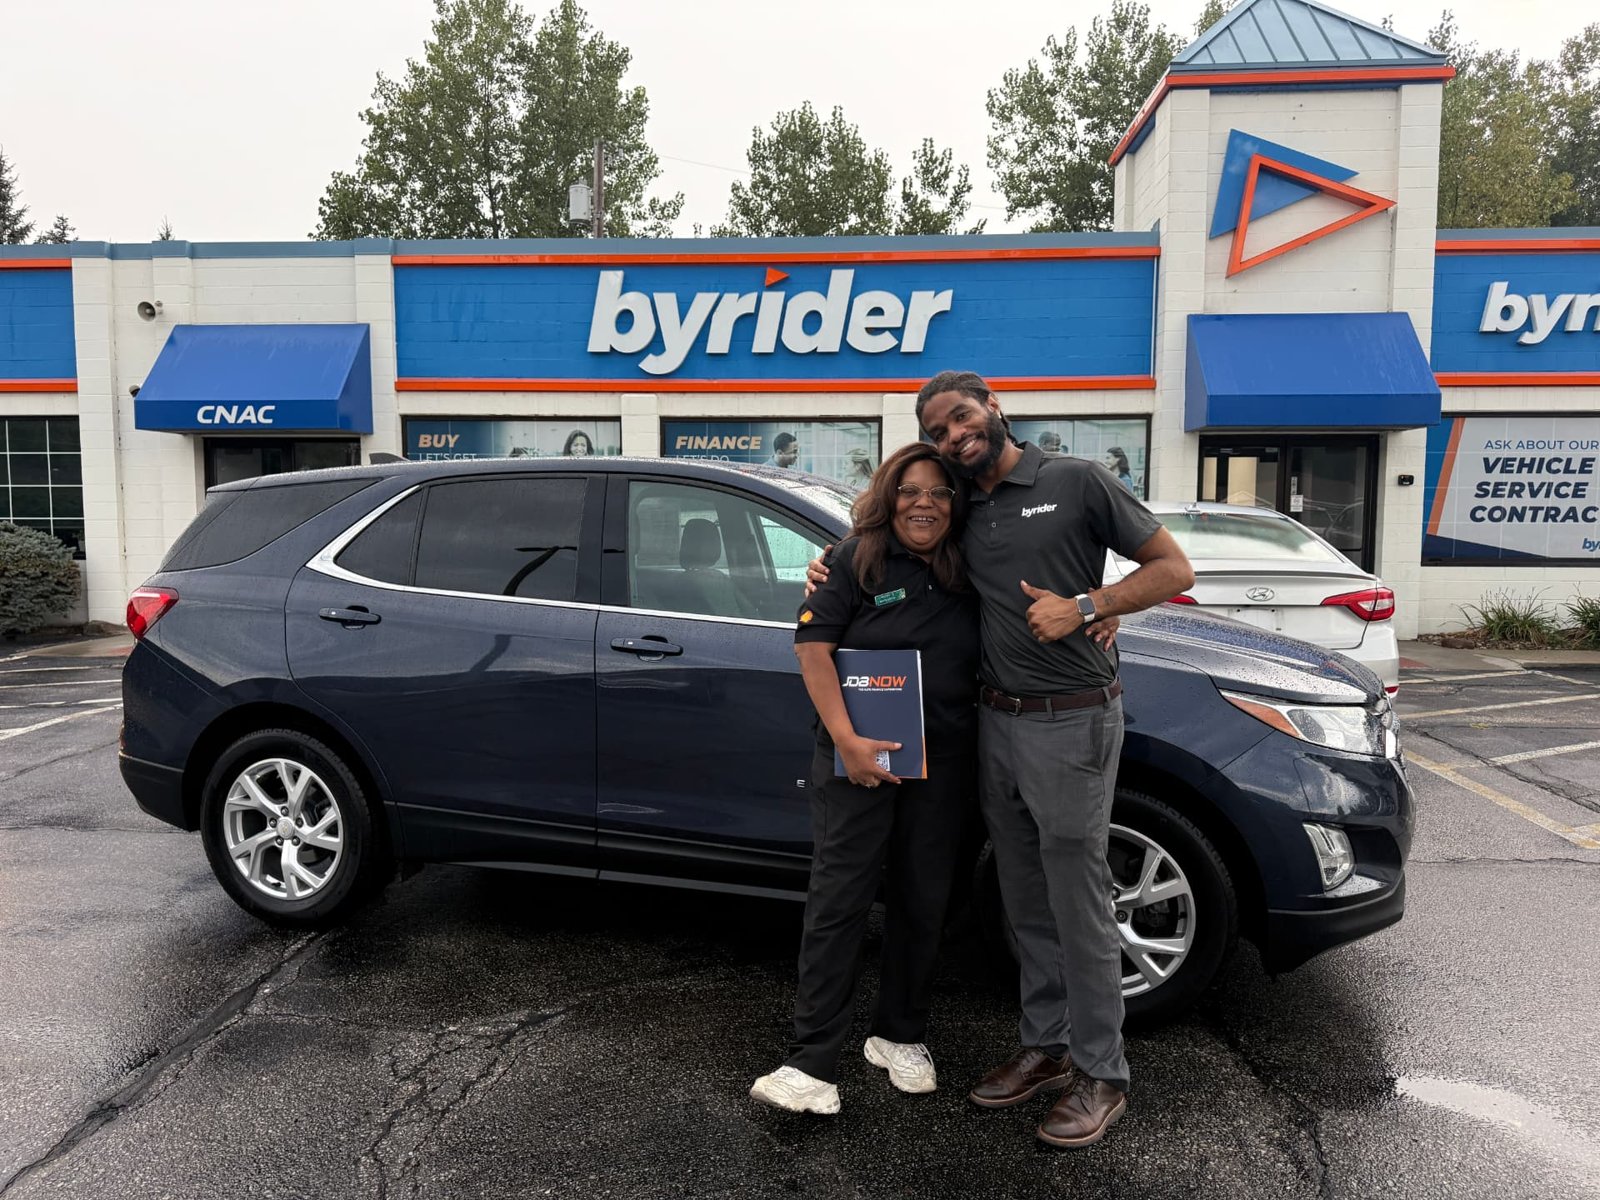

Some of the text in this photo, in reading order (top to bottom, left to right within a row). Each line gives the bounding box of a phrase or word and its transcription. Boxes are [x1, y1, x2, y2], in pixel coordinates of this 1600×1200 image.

[587, 267, 954, 375] byrider
[197, 405, 276, 424] CNAC
[418, 433, 460, 448] BUY
[675, 436, 762, 450] FINANCE
[1484, 440, 1599, 450] ASK ABOUT OUR
[1483, 457, 1596, 474] VEHICLE
[1474, 481, 1589, 499] SERVICE
[1021, 503, 1058, 518] byrider
